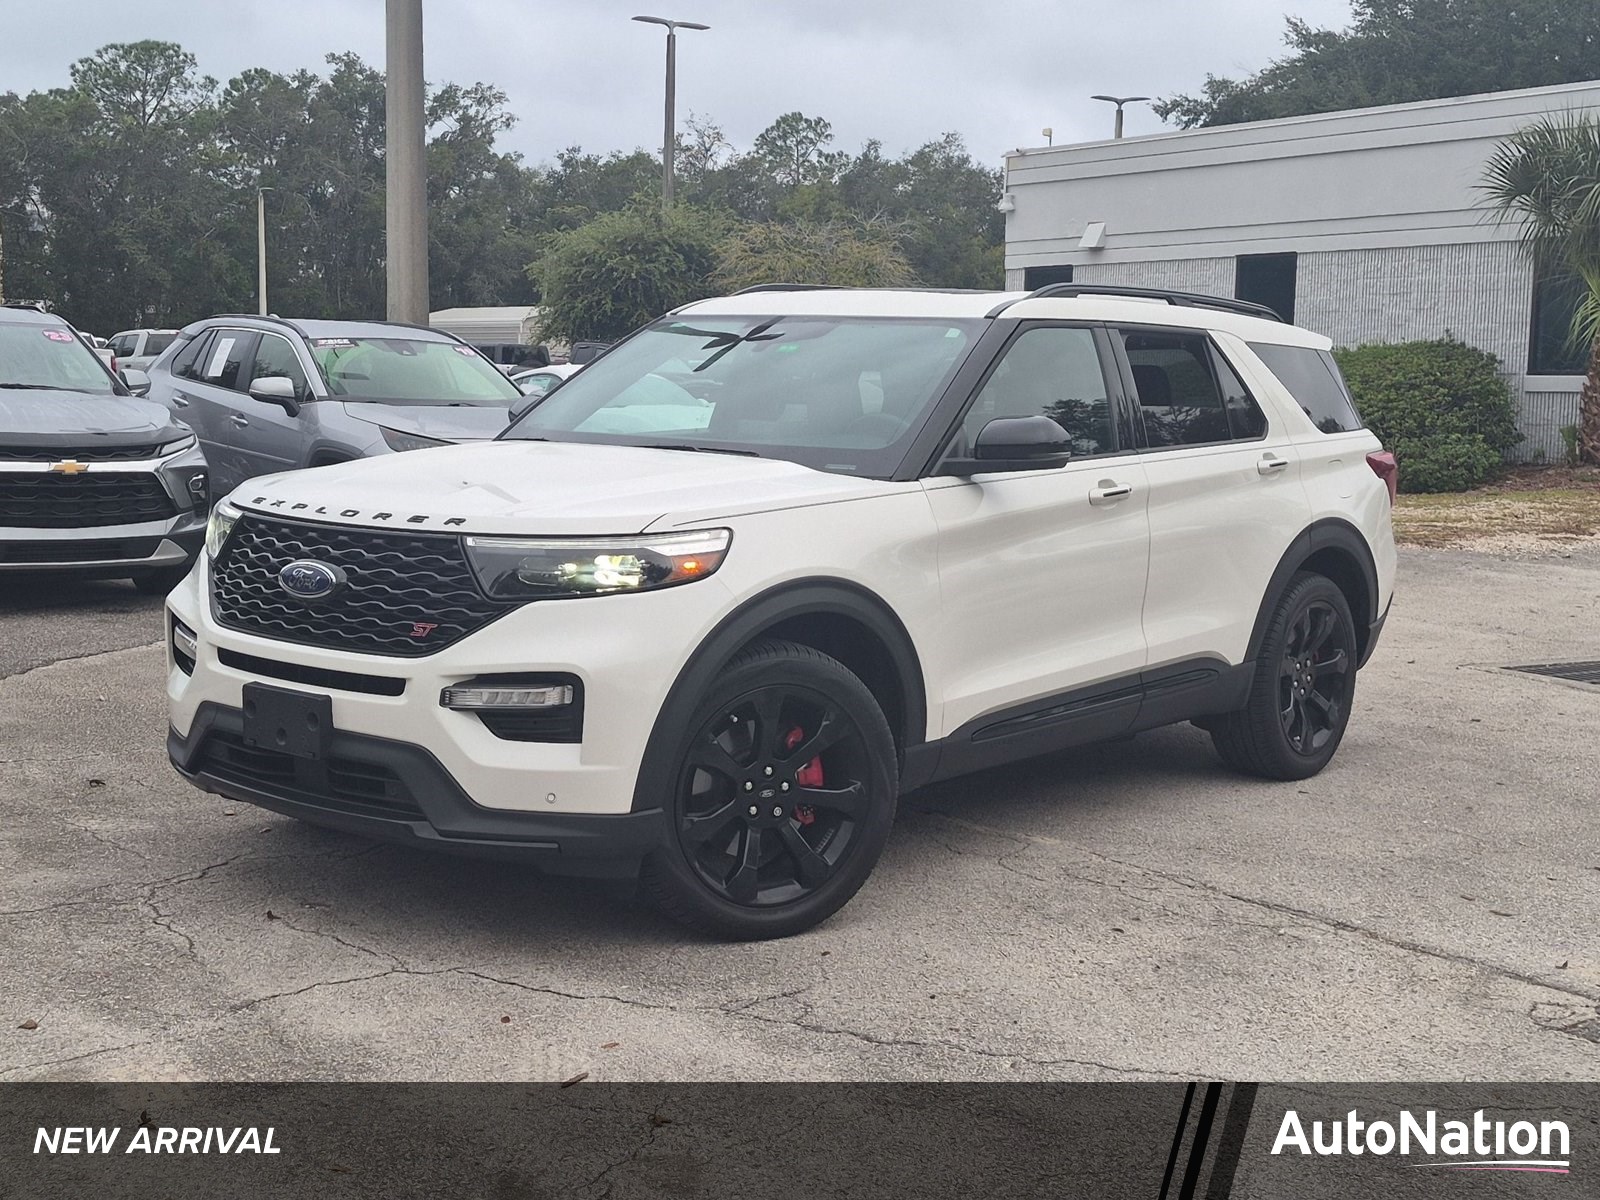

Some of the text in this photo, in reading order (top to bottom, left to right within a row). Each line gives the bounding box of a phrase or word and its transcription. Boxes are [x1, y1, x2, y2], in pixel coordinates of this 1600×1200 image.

[251, 496, 467, 527] EXPLORER
[287, 567, 322, 590] Ford
[410, 622, 439, 637] ST
